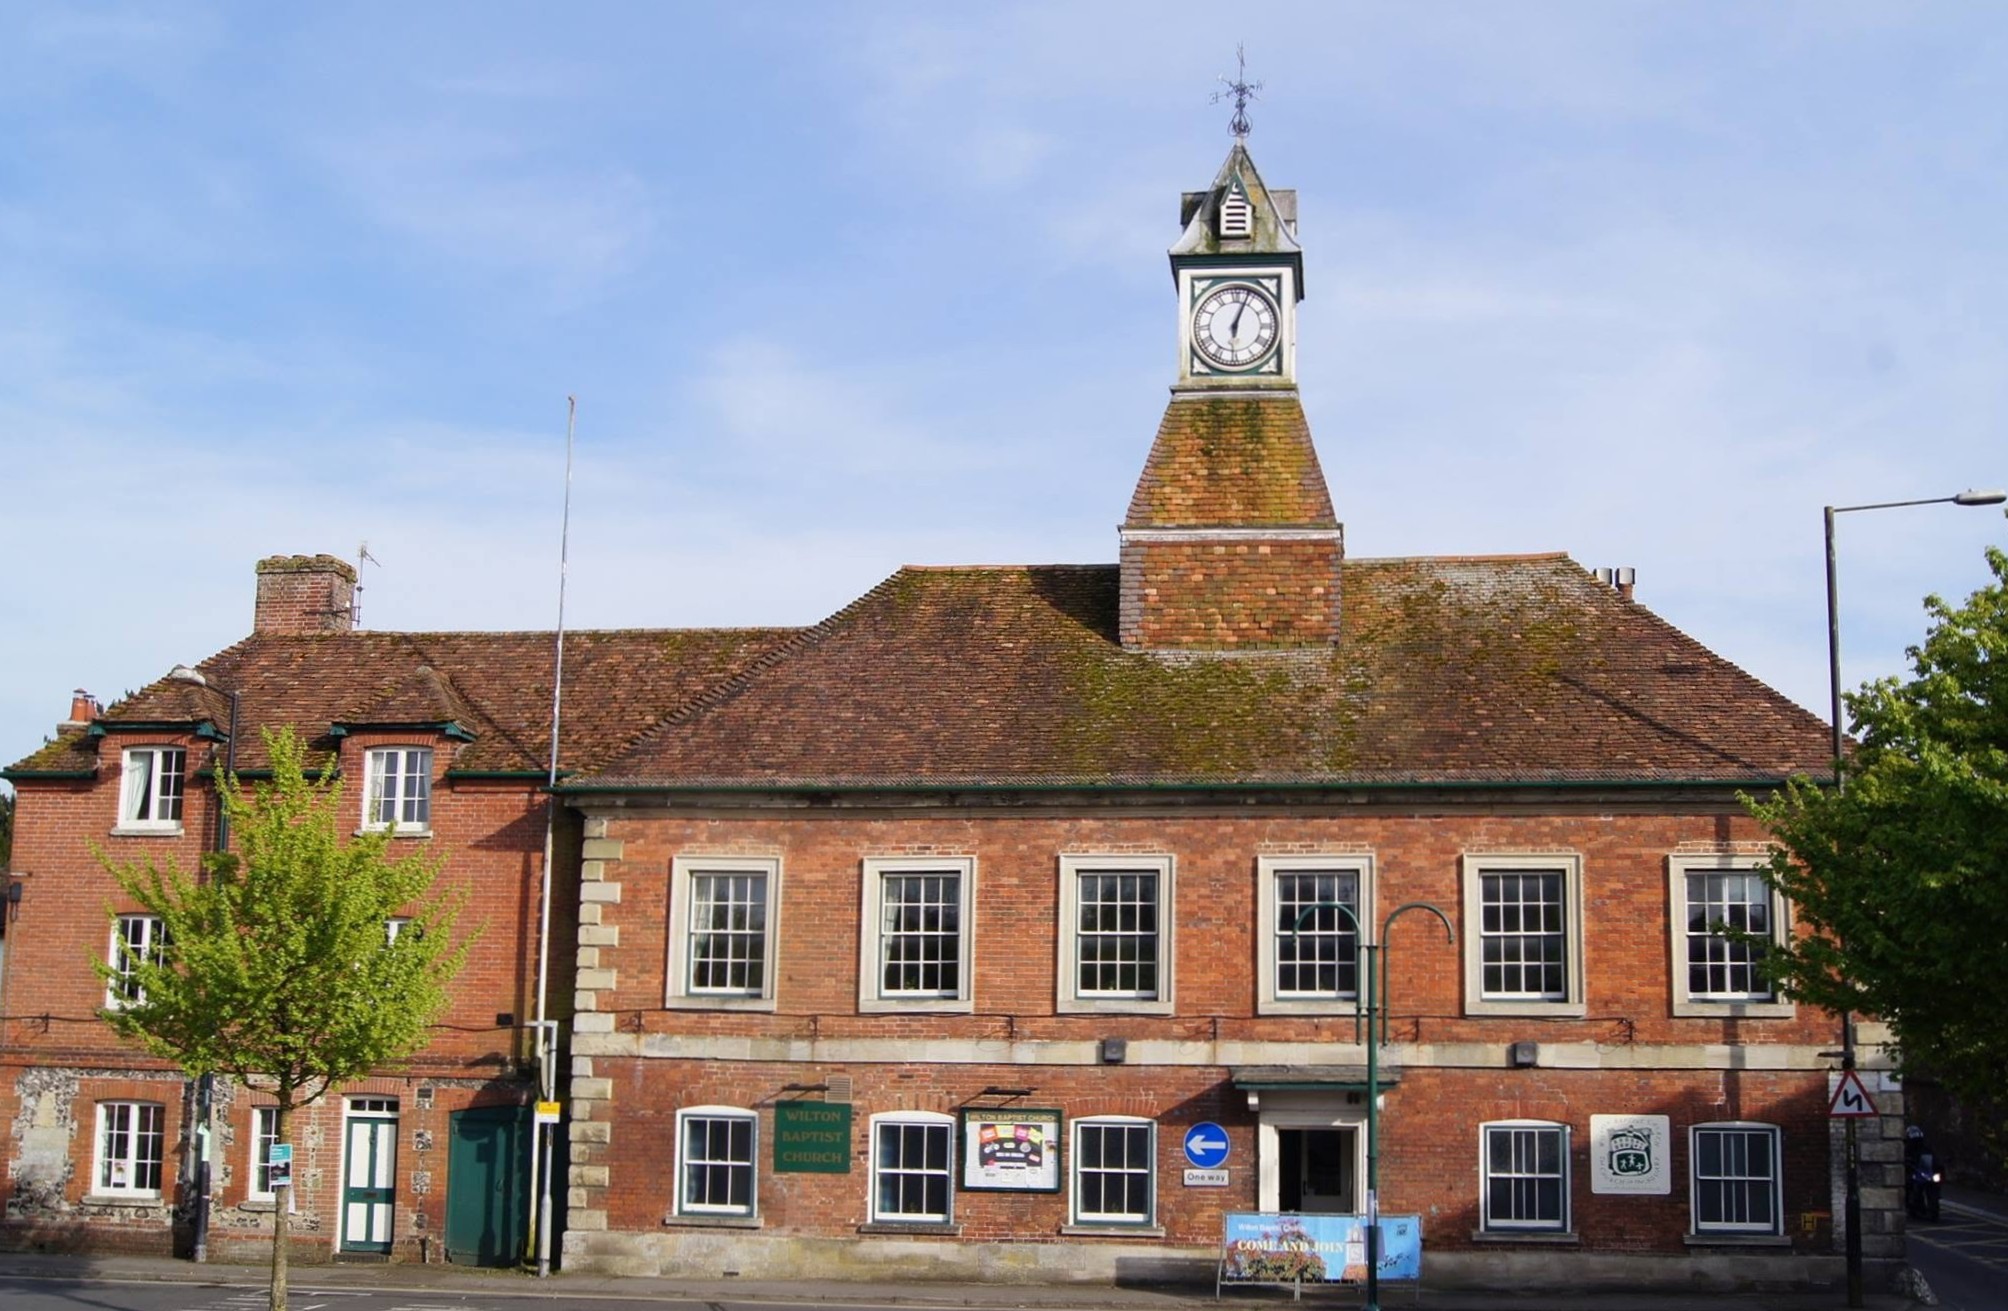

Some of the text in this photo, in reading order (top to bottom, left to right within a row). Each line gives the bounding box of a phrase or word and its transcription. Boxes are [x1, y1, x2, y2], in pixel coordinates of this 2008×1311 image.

[785, 1110, 841, 1122] WILTON
[782, 1130, 843, 1143] BAPTIST
[782, 1151, 842, 1163] CHURCH
[1187, 1172, 1206, 1181] One
[1804, 1215, 1814, 1229] H
[1237, 1239, 1345, 1253] COME AND JOIN
